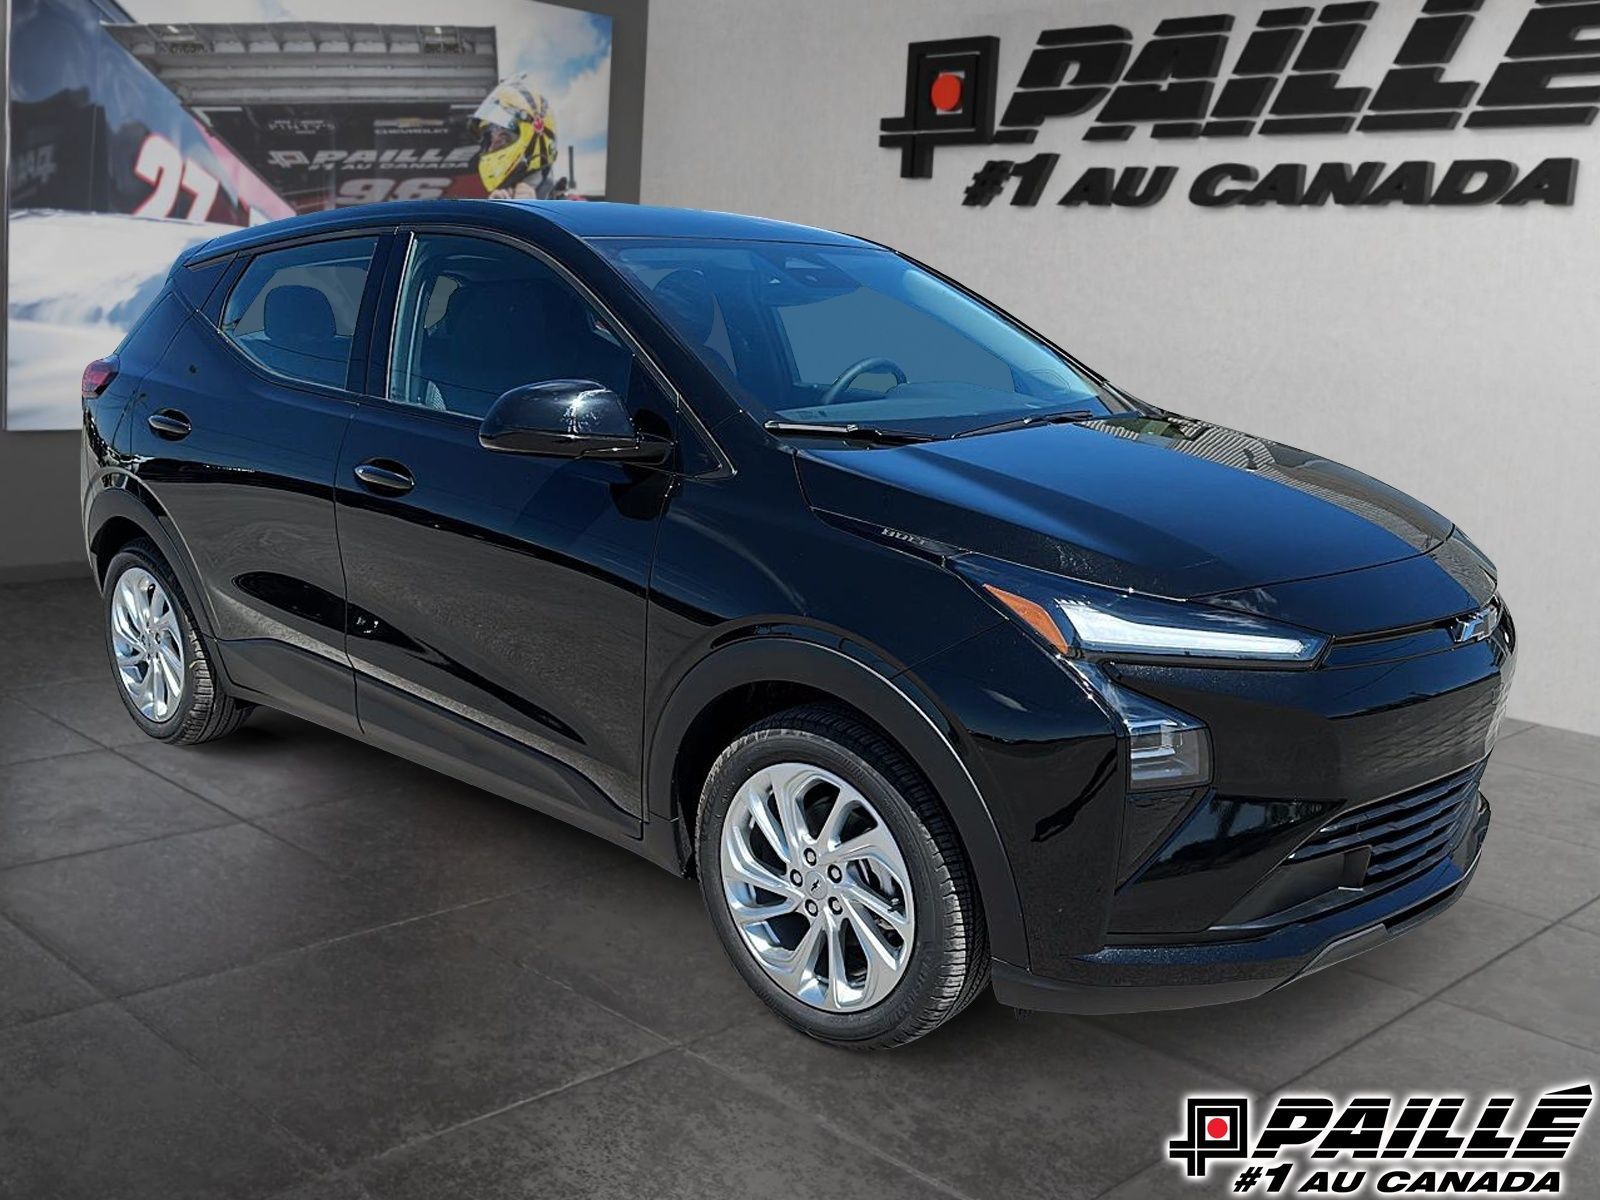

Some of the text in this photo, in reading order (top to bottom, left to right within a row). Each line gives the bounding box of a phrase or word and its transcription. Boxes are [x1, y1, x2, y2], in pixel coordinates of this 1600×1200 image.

[133, 132, 220, 222] 27
[341, 162, 372, 171] AU
[378, 161, 470, 170] CANADA
[963, 153, 1579, 207] #1 AU CANADA
[334, 176, 452, 205] 96
